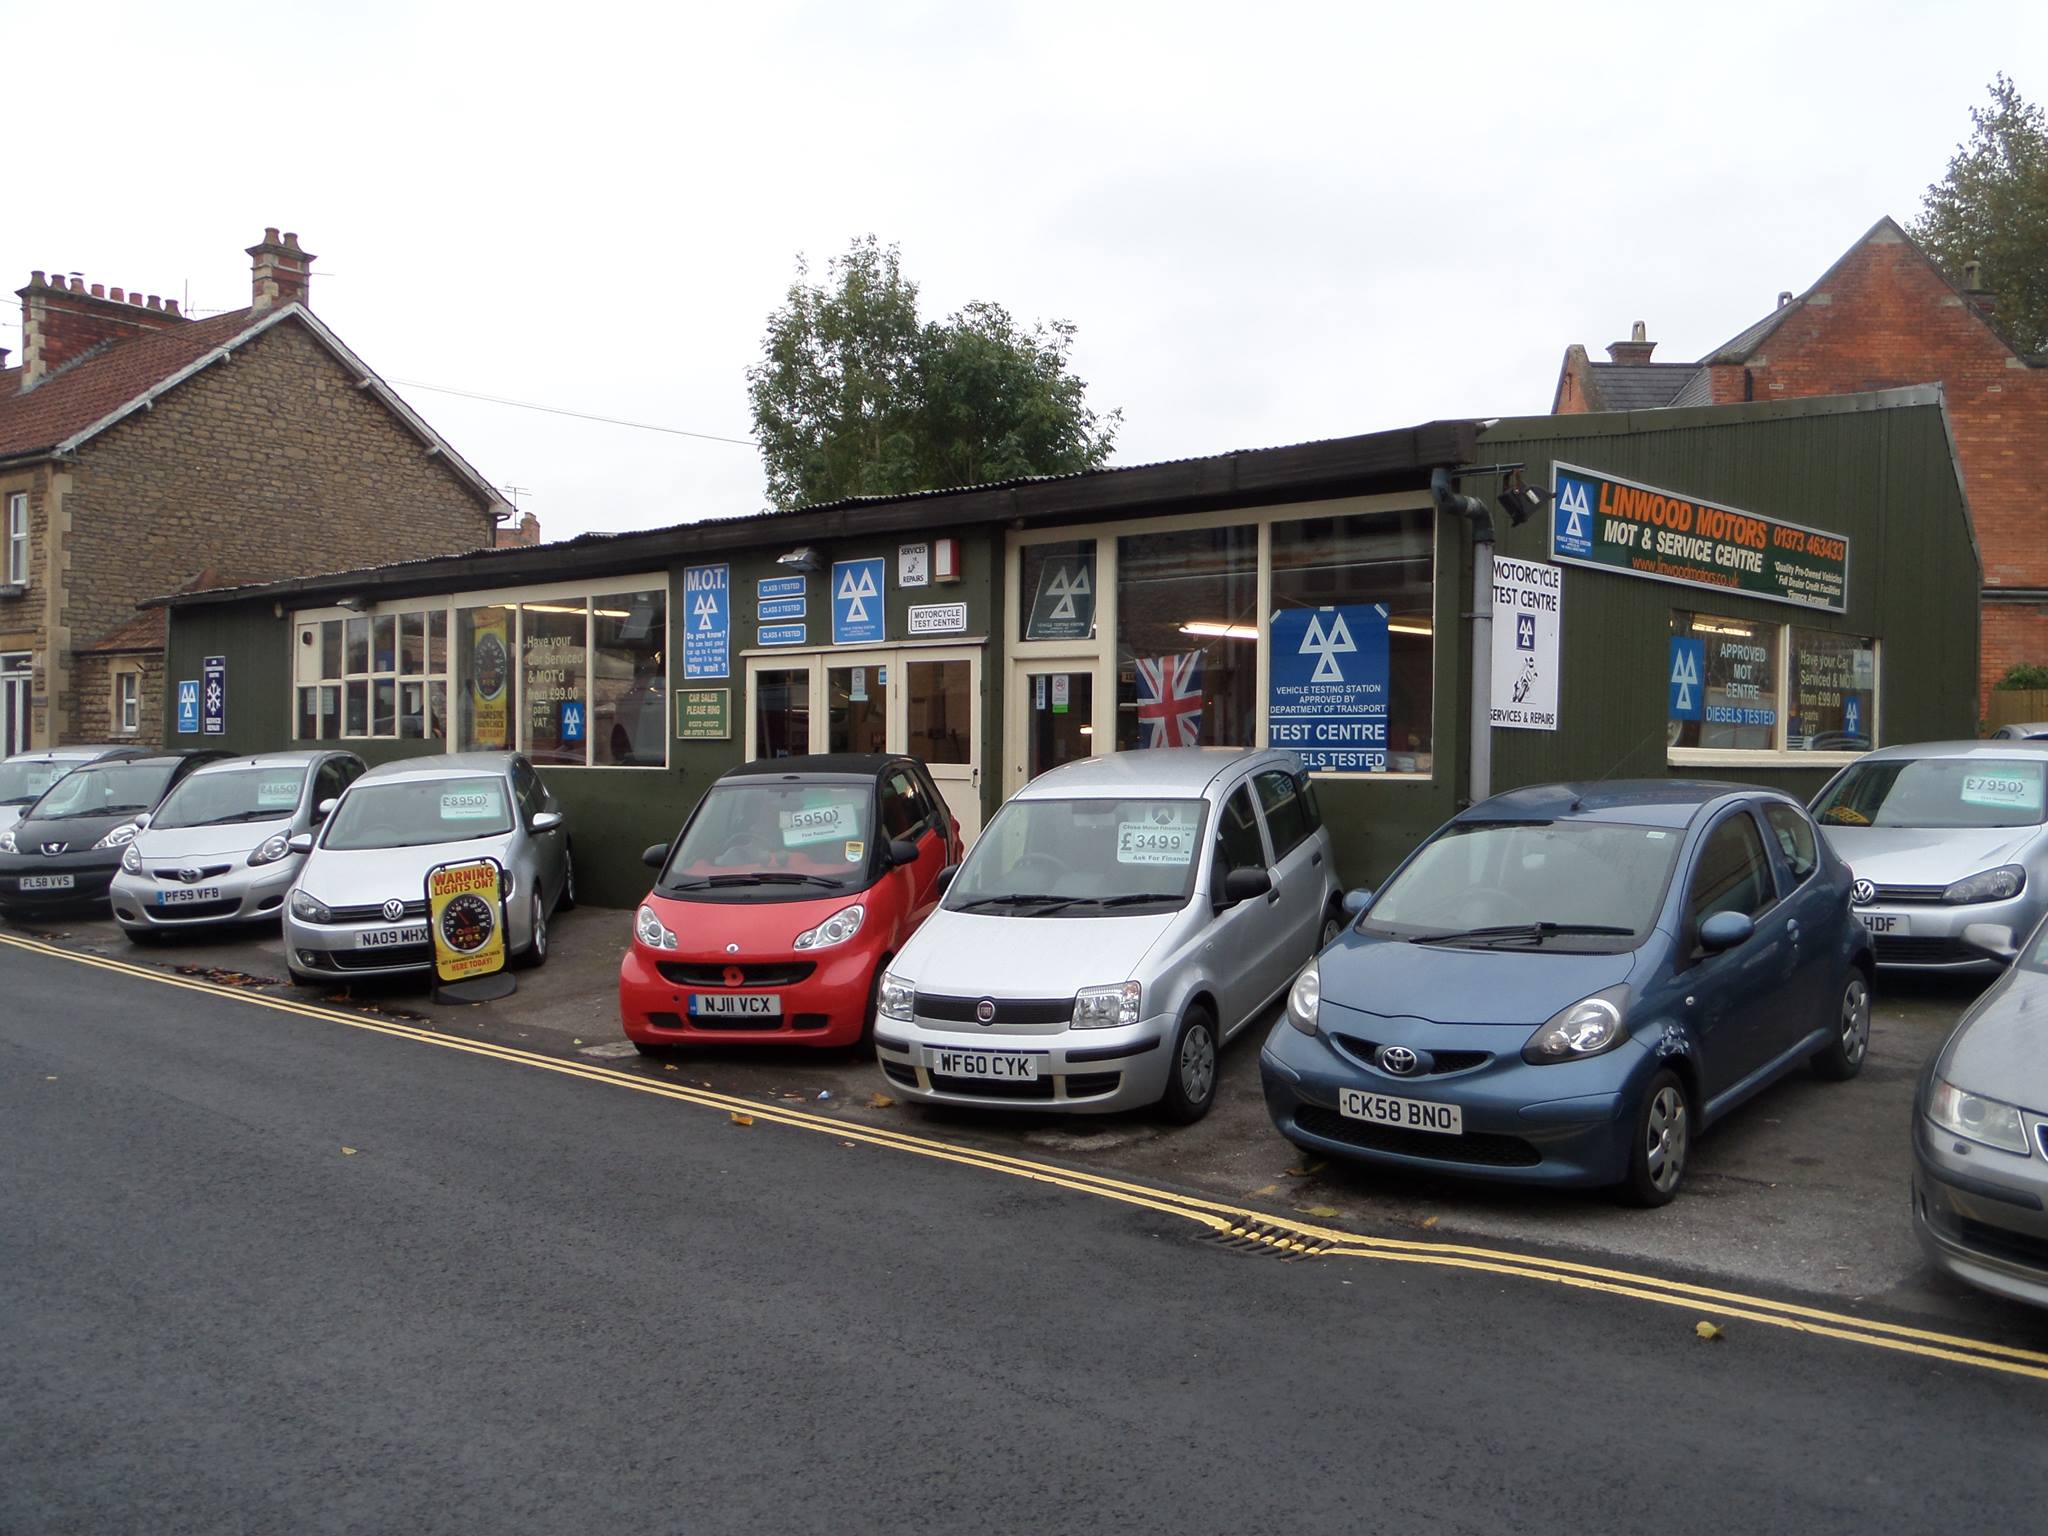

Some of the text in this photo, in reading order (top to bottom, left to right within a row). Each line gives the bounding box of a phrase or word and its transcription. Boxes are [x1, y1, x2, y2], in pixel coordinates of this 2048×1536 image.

[1599, 481, 1768, 551] LINWOOD MOTORS
[900, 546, 926, 556] SERVICES
[1603, 519, 1639, 547] MOT
[1641, 528, 1652, 550] &
[1656, 530, 1712, 563] SERVICE
[1715, 543, 1763, 574] CENTRE
[1774, 525, 1845, 561] 01373 463433
[687, 567, 726, 592] M.O.T.
[902, 574, 924, 583] REPAIRS
[1493, 559, 1559, 589] MOTORCYCLE
[762, 584, 778, 593] CLASS
[781, 582, 800, 590] TESTED
[1493, 585, 1557, 612] TEST CENTRE
[762, 606, 778, 614] CLASS
[782, 604, 800, 612] TESTED
[914, 608, 961, 620] MOTORCYCLE
[914, 617, 961, 628] TEST CENTRE
[527, 635, 572, 650] Have your
[762, 631, 778, 639] CLASS
[781, 630, 801, 638] TESTED
[544, 652, 584, 666] Serviced
[1720, 642, 1767, 663] APPROVED
[1800, 650, 1819, 668] Have
[1819, 654, 1837, 669] your
[527, 670, 536, 683] &
[1733, 663, 1753, 680] MOT
[1800, 670, 1831, 688] Serviced
[1832, 674, 1839, 688] &
[549, 686, 579, 701] £99.00
[1276, 684, 1381, 695] VEHICLE TESTING STATION
[1726, 683, 1760, 700] CENTRE
[1299, 695, 1356, 704] APPROVED BY
[1800, 691, 1841, 707] from £99.00
[1270, 704, 1386, 714] DEPARTMENT OF TRANSPORT
[1490, 708, 1555, 726] SERVICES & REPAIRS
[1706, 706, 1776, 726] DIESELS TESTED
[1270, 724, 1385, 740] TEST CENTRE
[1301, 752, 1385, 767] ELS TESTED
[1966, 778, 2018, 793] £7950
[443, 795, 482, 807] £8950
[23, 877, 48, 888] FL58
[434, 867, 494, 887] WARNING
[164, 887, 219, 902] PF59 VFB
[434, 878, 494, 896] LIGHTS ON?
[362, 928, 428, 946] NA09 MHX
[705, 997, 770, 1013] NJ11 VCX
[941, 1053, 1030, 1077] WF60 CYK
[1348, 1093, 1452, 1129] CK58 BNO
